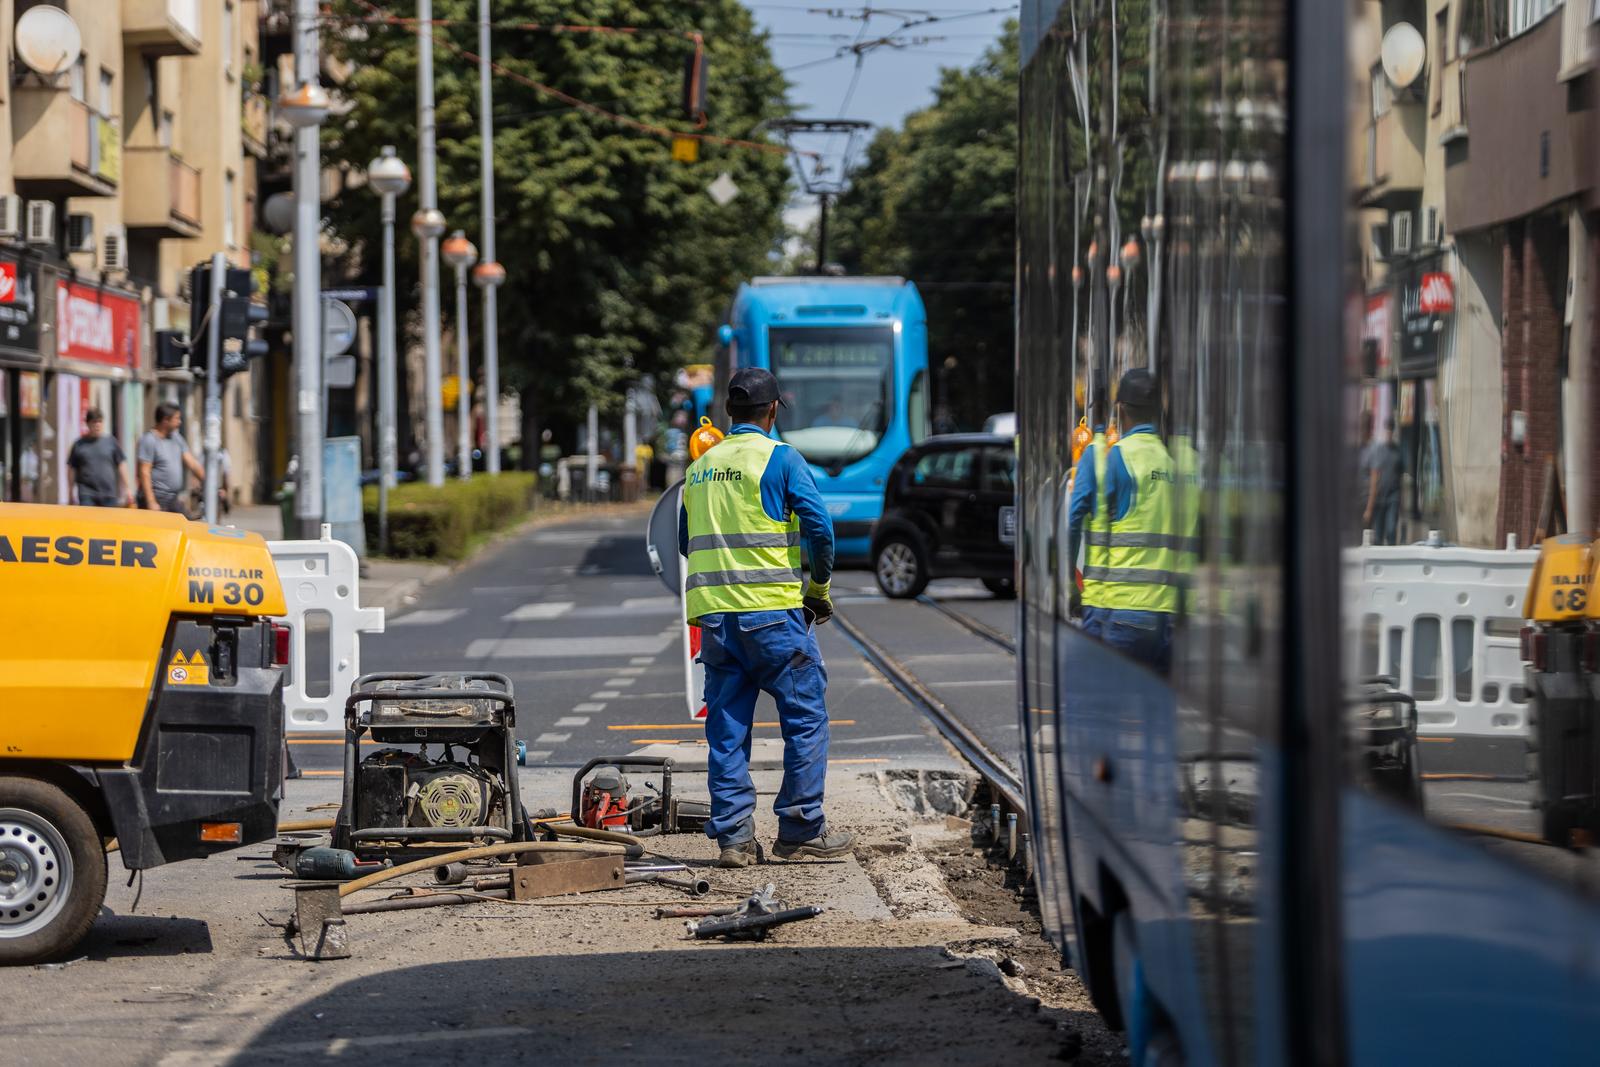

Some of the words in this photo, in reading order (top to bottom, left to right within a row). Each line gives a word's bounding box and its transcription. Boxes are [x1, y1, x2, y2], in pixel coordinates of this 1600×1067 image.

[188, 566, 264, 579] MOBILAIR
[188, 580, 214, 604] M
[223, 583, 264, 606] 30
